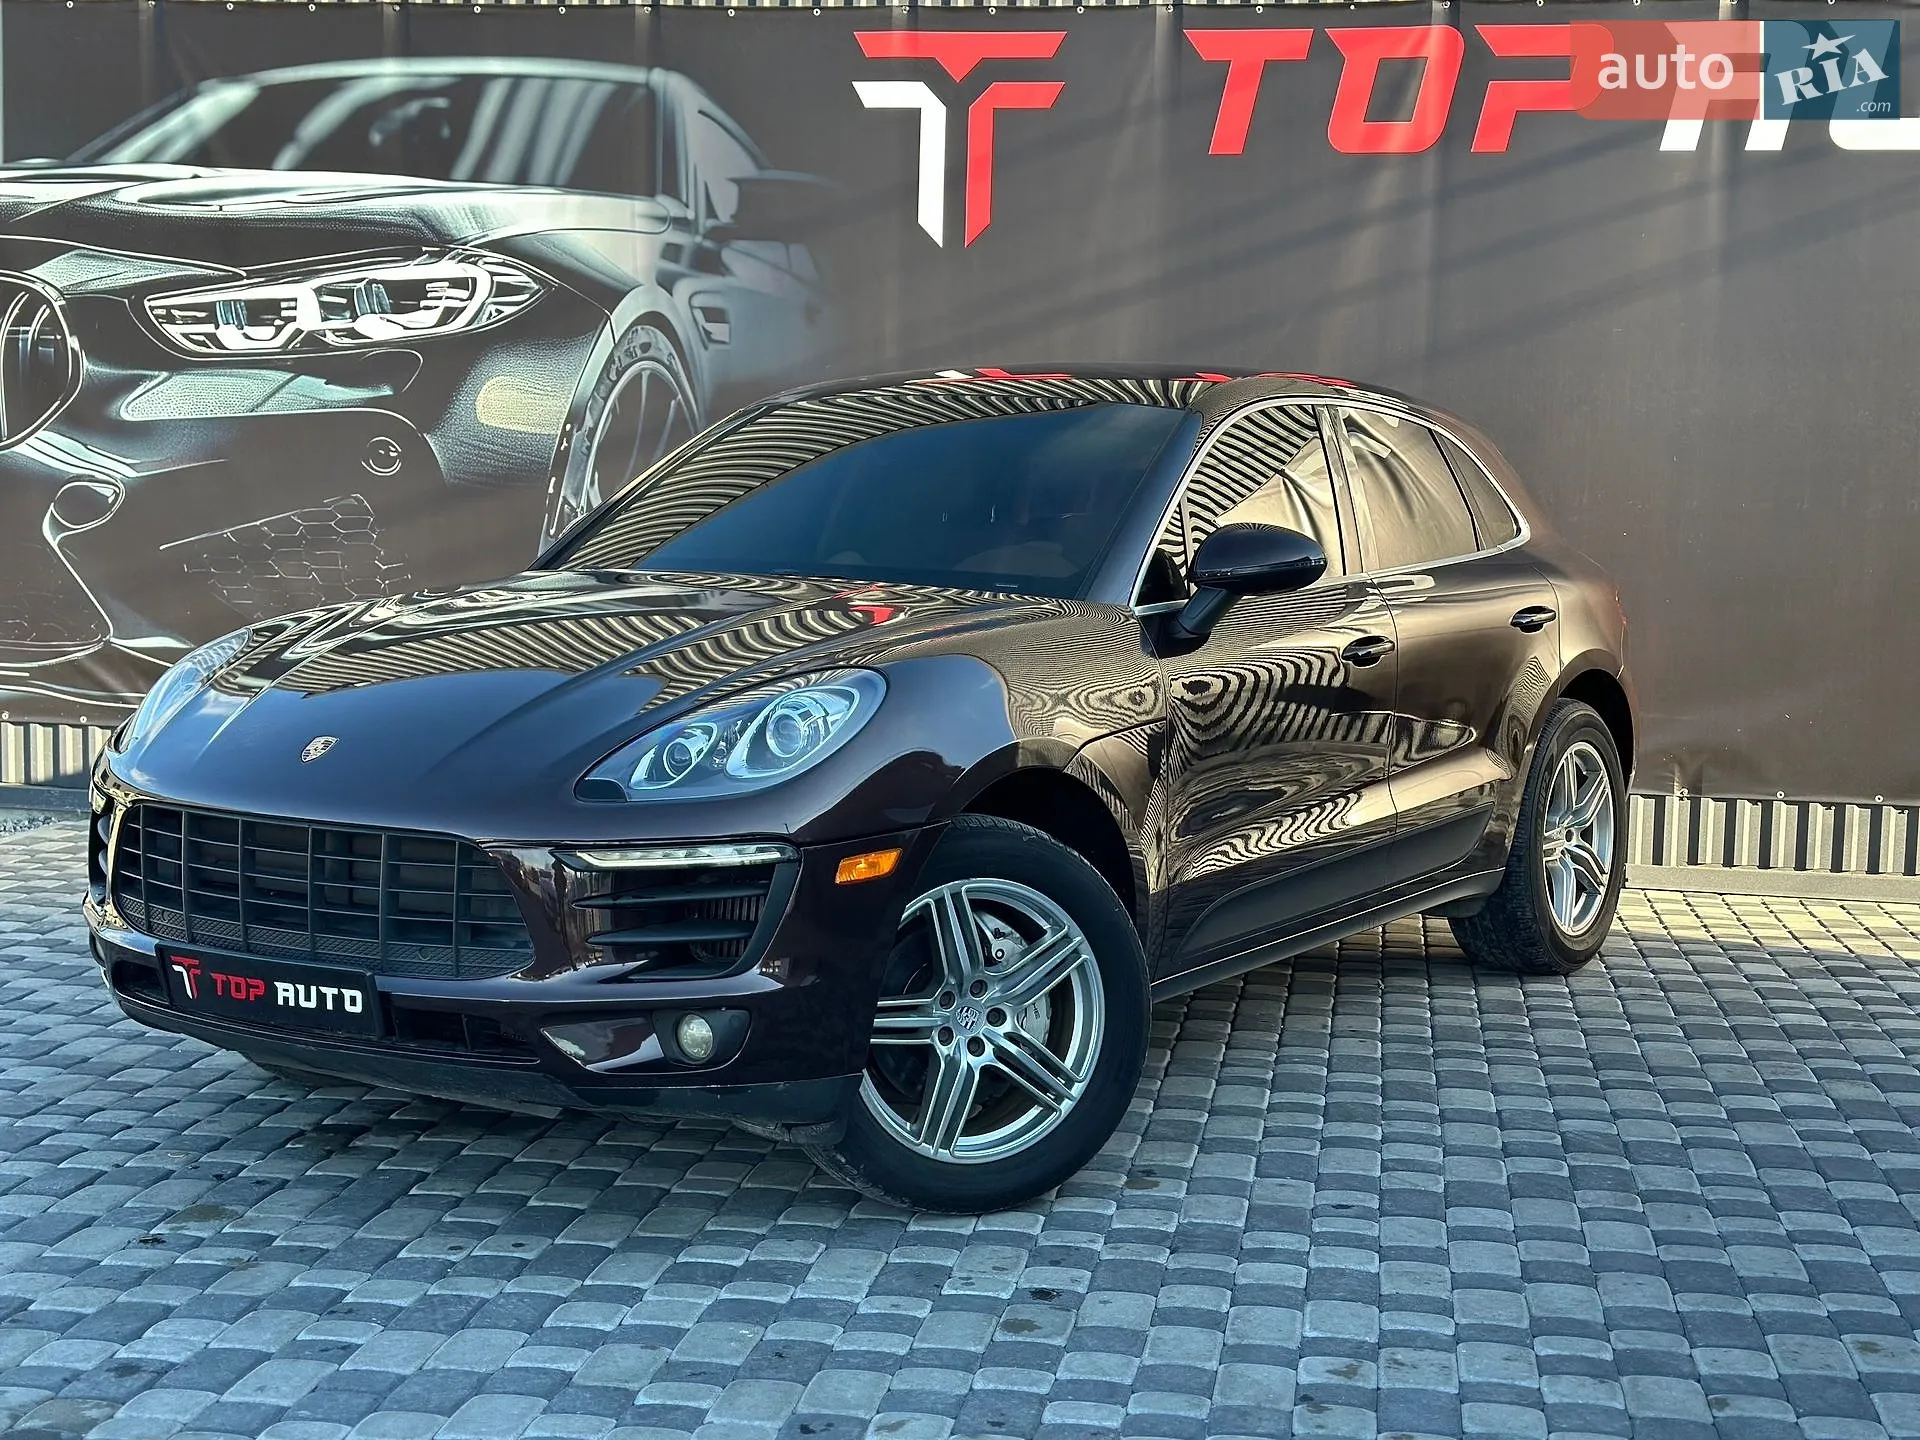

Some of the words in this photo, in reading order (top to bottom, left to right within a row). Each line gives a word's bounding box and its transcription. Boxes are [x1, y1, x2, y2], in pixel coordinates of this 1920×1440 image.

[1183, 23, 1615, 156] TOP
[210, 972, 266, 1002] TOP
[273, 981, 363, 1014] AUTO
